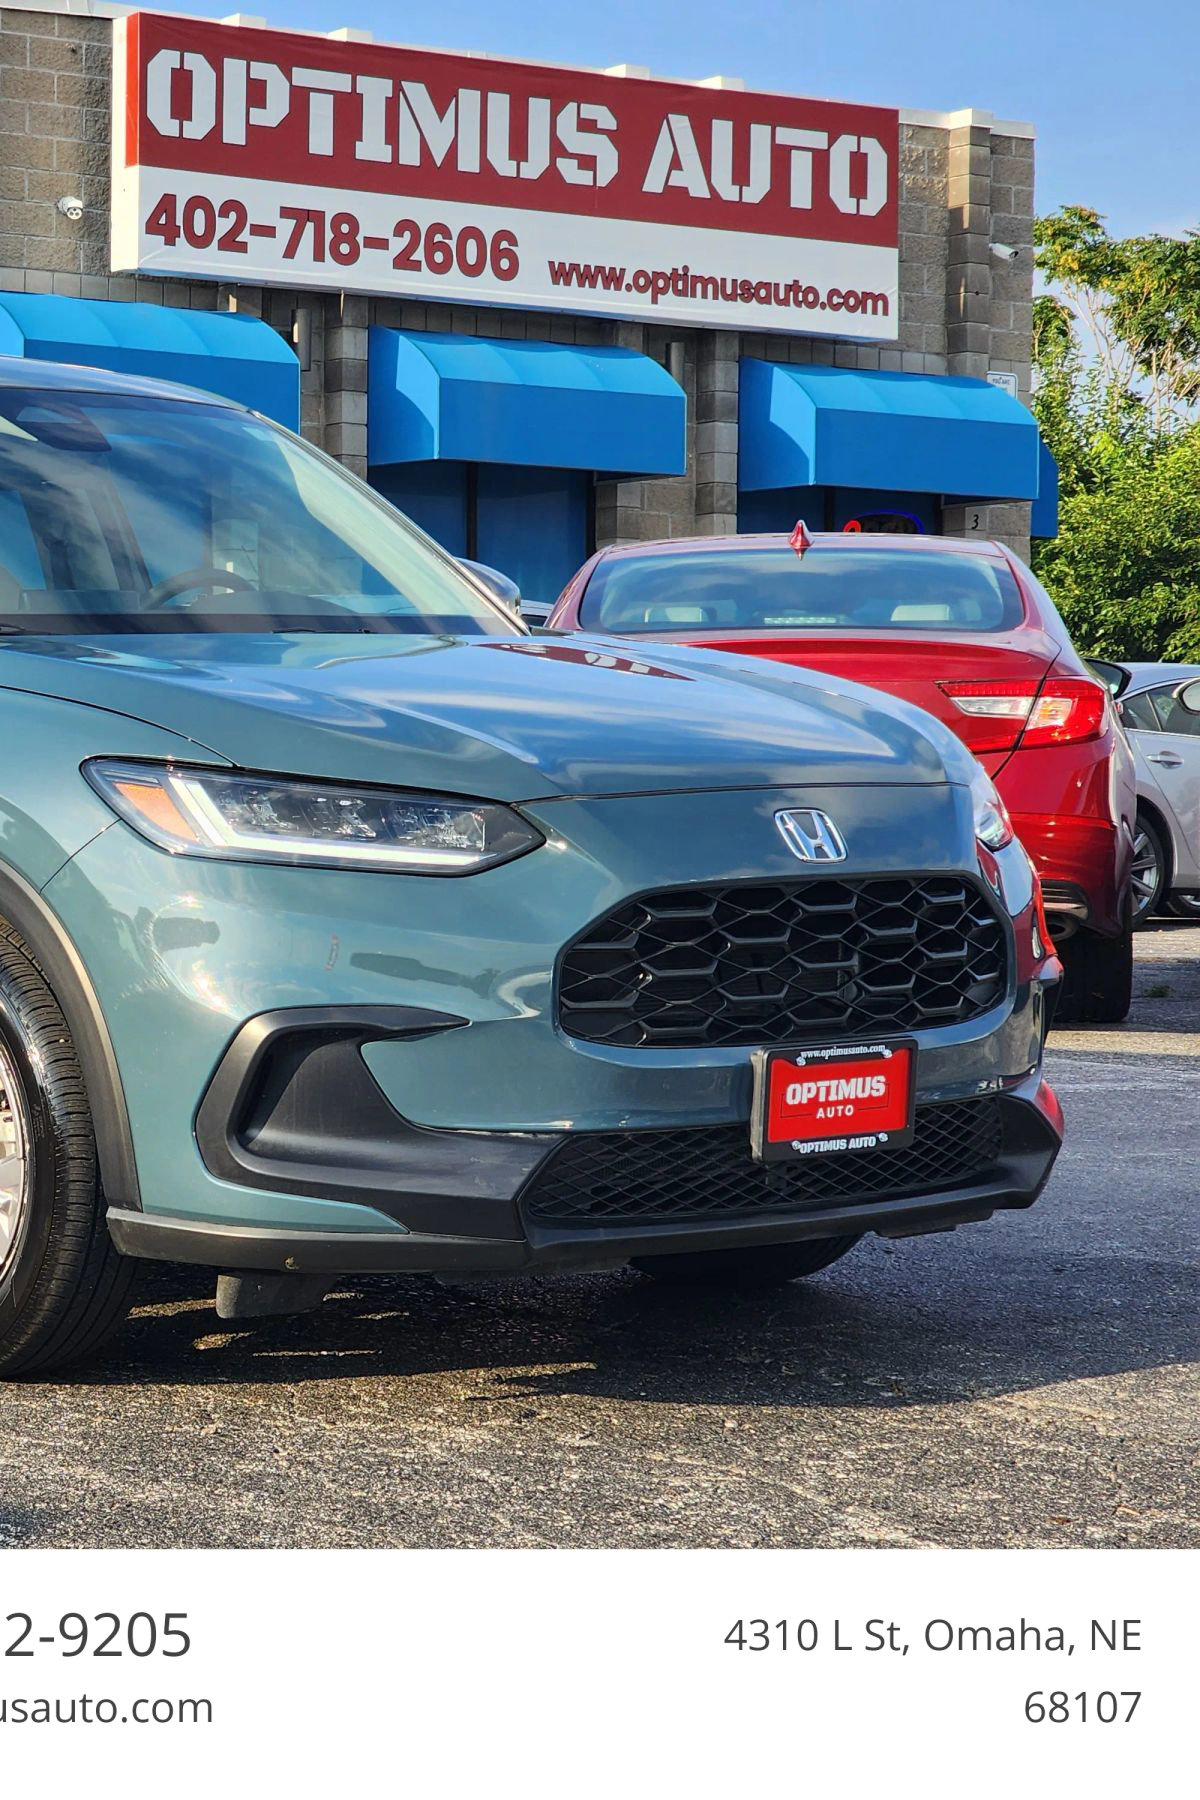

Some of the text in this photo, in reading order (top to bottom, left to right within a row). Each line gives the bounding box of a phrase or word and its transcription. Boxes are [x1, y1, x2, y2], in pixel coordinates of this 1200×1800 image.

[146, 48, 888, 217] OPTIMUS AUTO
[145, 193, 519, 282] 402-718-2606
[548, 256, 889, 317] www.optimusauto.com
[971, 514, 979, 529] 3
[801, 1044, 886, 1059] www.optimusauto.com
[786, 1075, 886, 1105] OPTIMUS
[816, 1104, 854, 1119] AUTO
[800, 1136, 877, 1154] OPTIMUS AUTO
